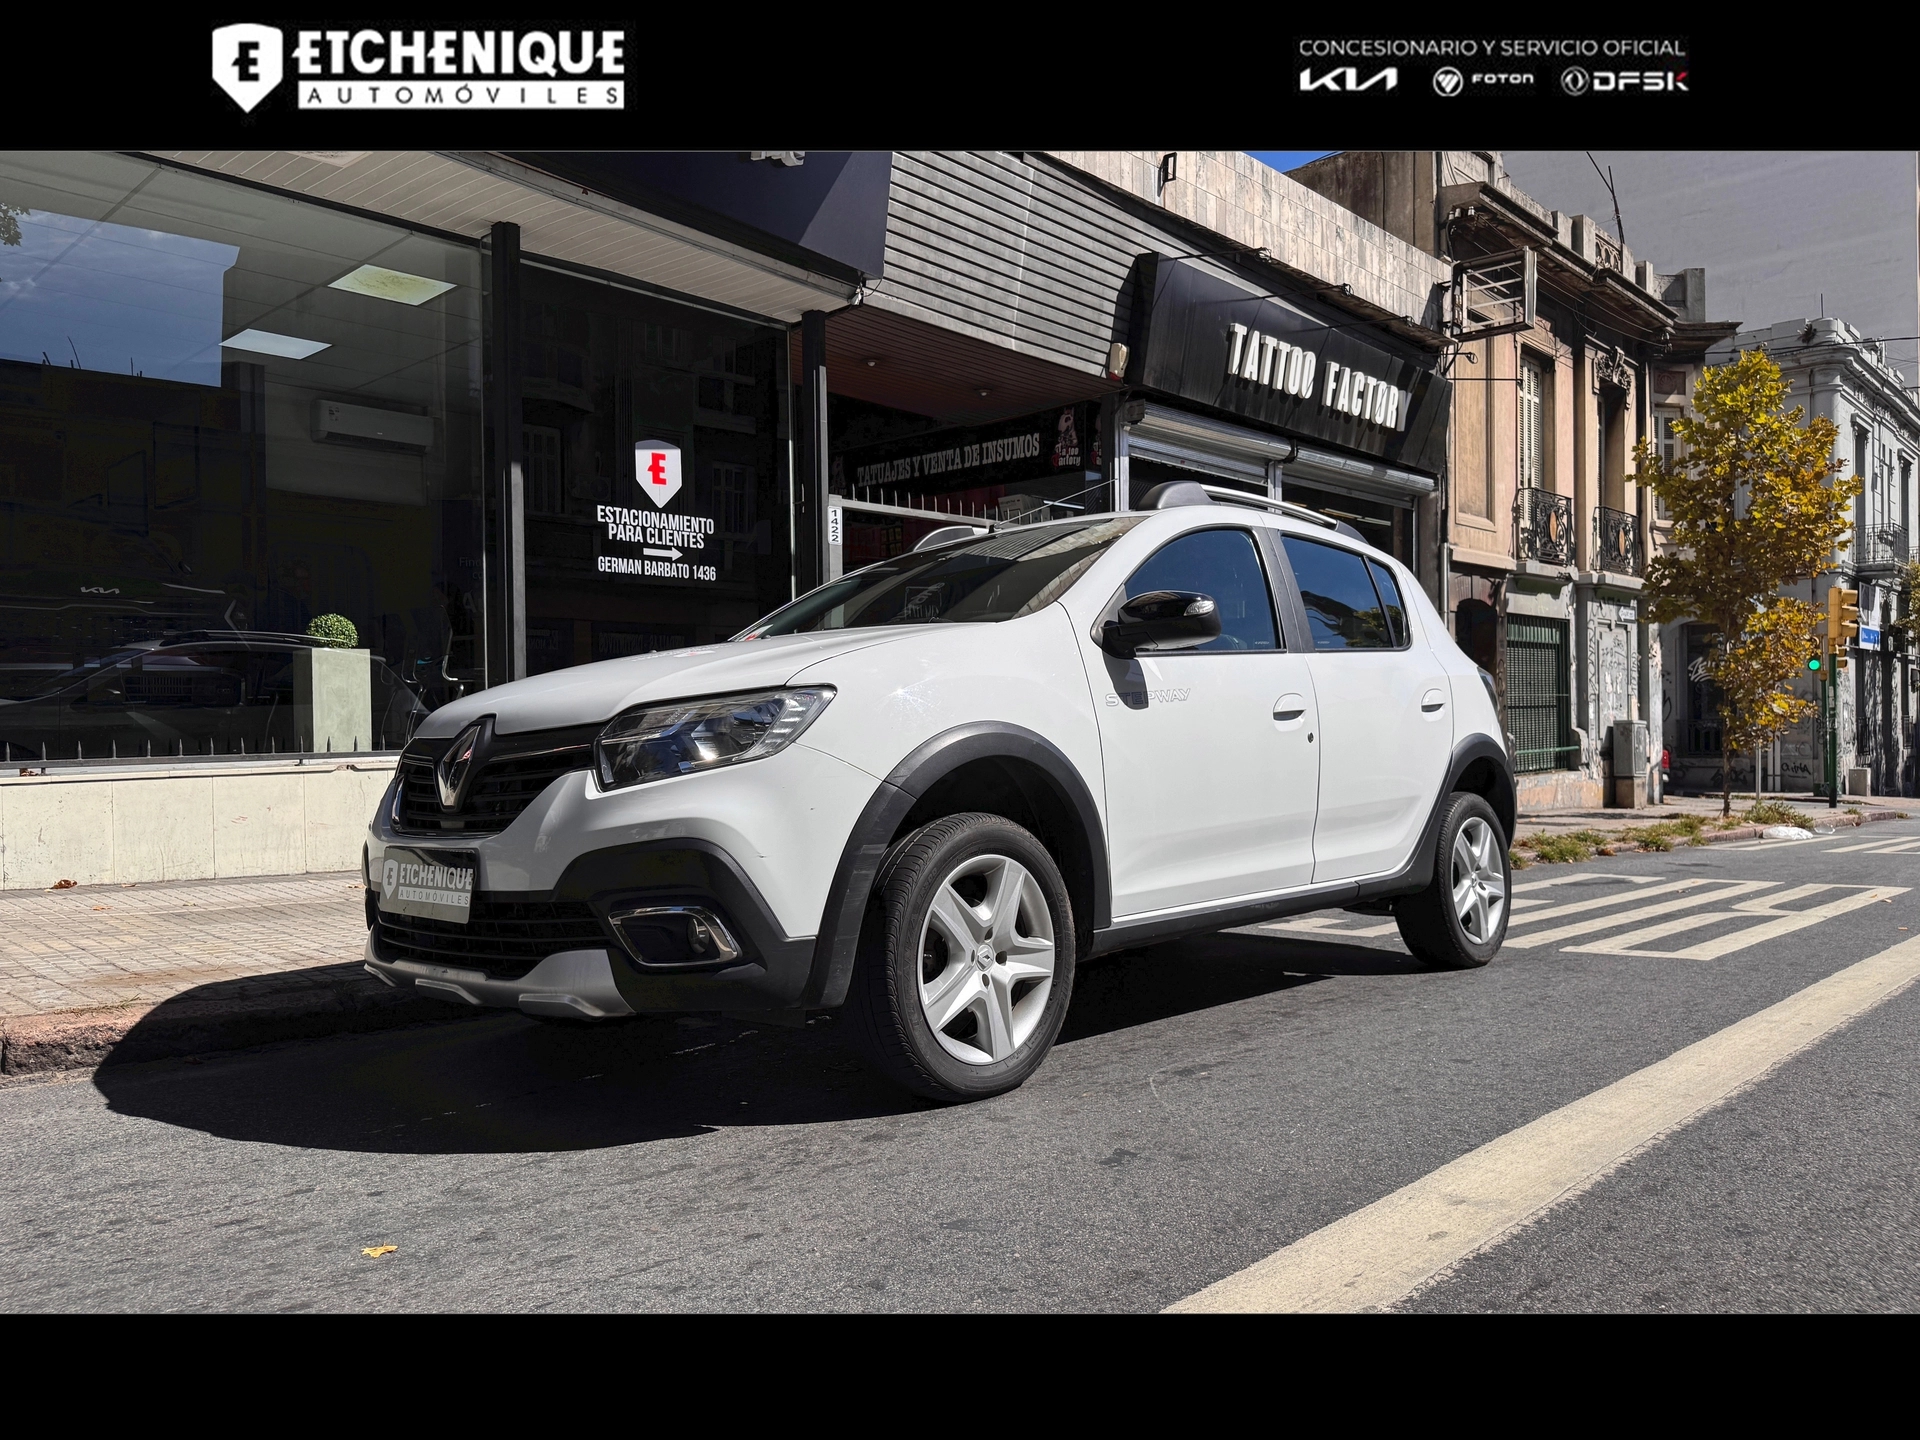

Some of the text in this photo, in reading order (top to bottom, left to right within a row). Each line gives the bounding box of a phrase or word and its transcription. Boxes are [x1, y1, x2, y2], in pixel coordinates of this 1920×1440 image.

[1228, 322, 1412, 432] TATTOO FACTORY
[857, 433, 1040, 487] TATUAJES Y VENTA DE INSUMOS
[597, 504, 715, 534] ESTACIONAMIENTO
[831, 509, 840, 543] 1422
[608, 523, 705, 549] PARA CLIENTES
[598, 556, 717, 581] GERMAN BARBATO 1436
[1105, 688, 1191, 707] STEPWAY
[399, 863, 474, 890] ETCHENIQUE
[399, 890, 469, 905] AUTOMÓVILES
